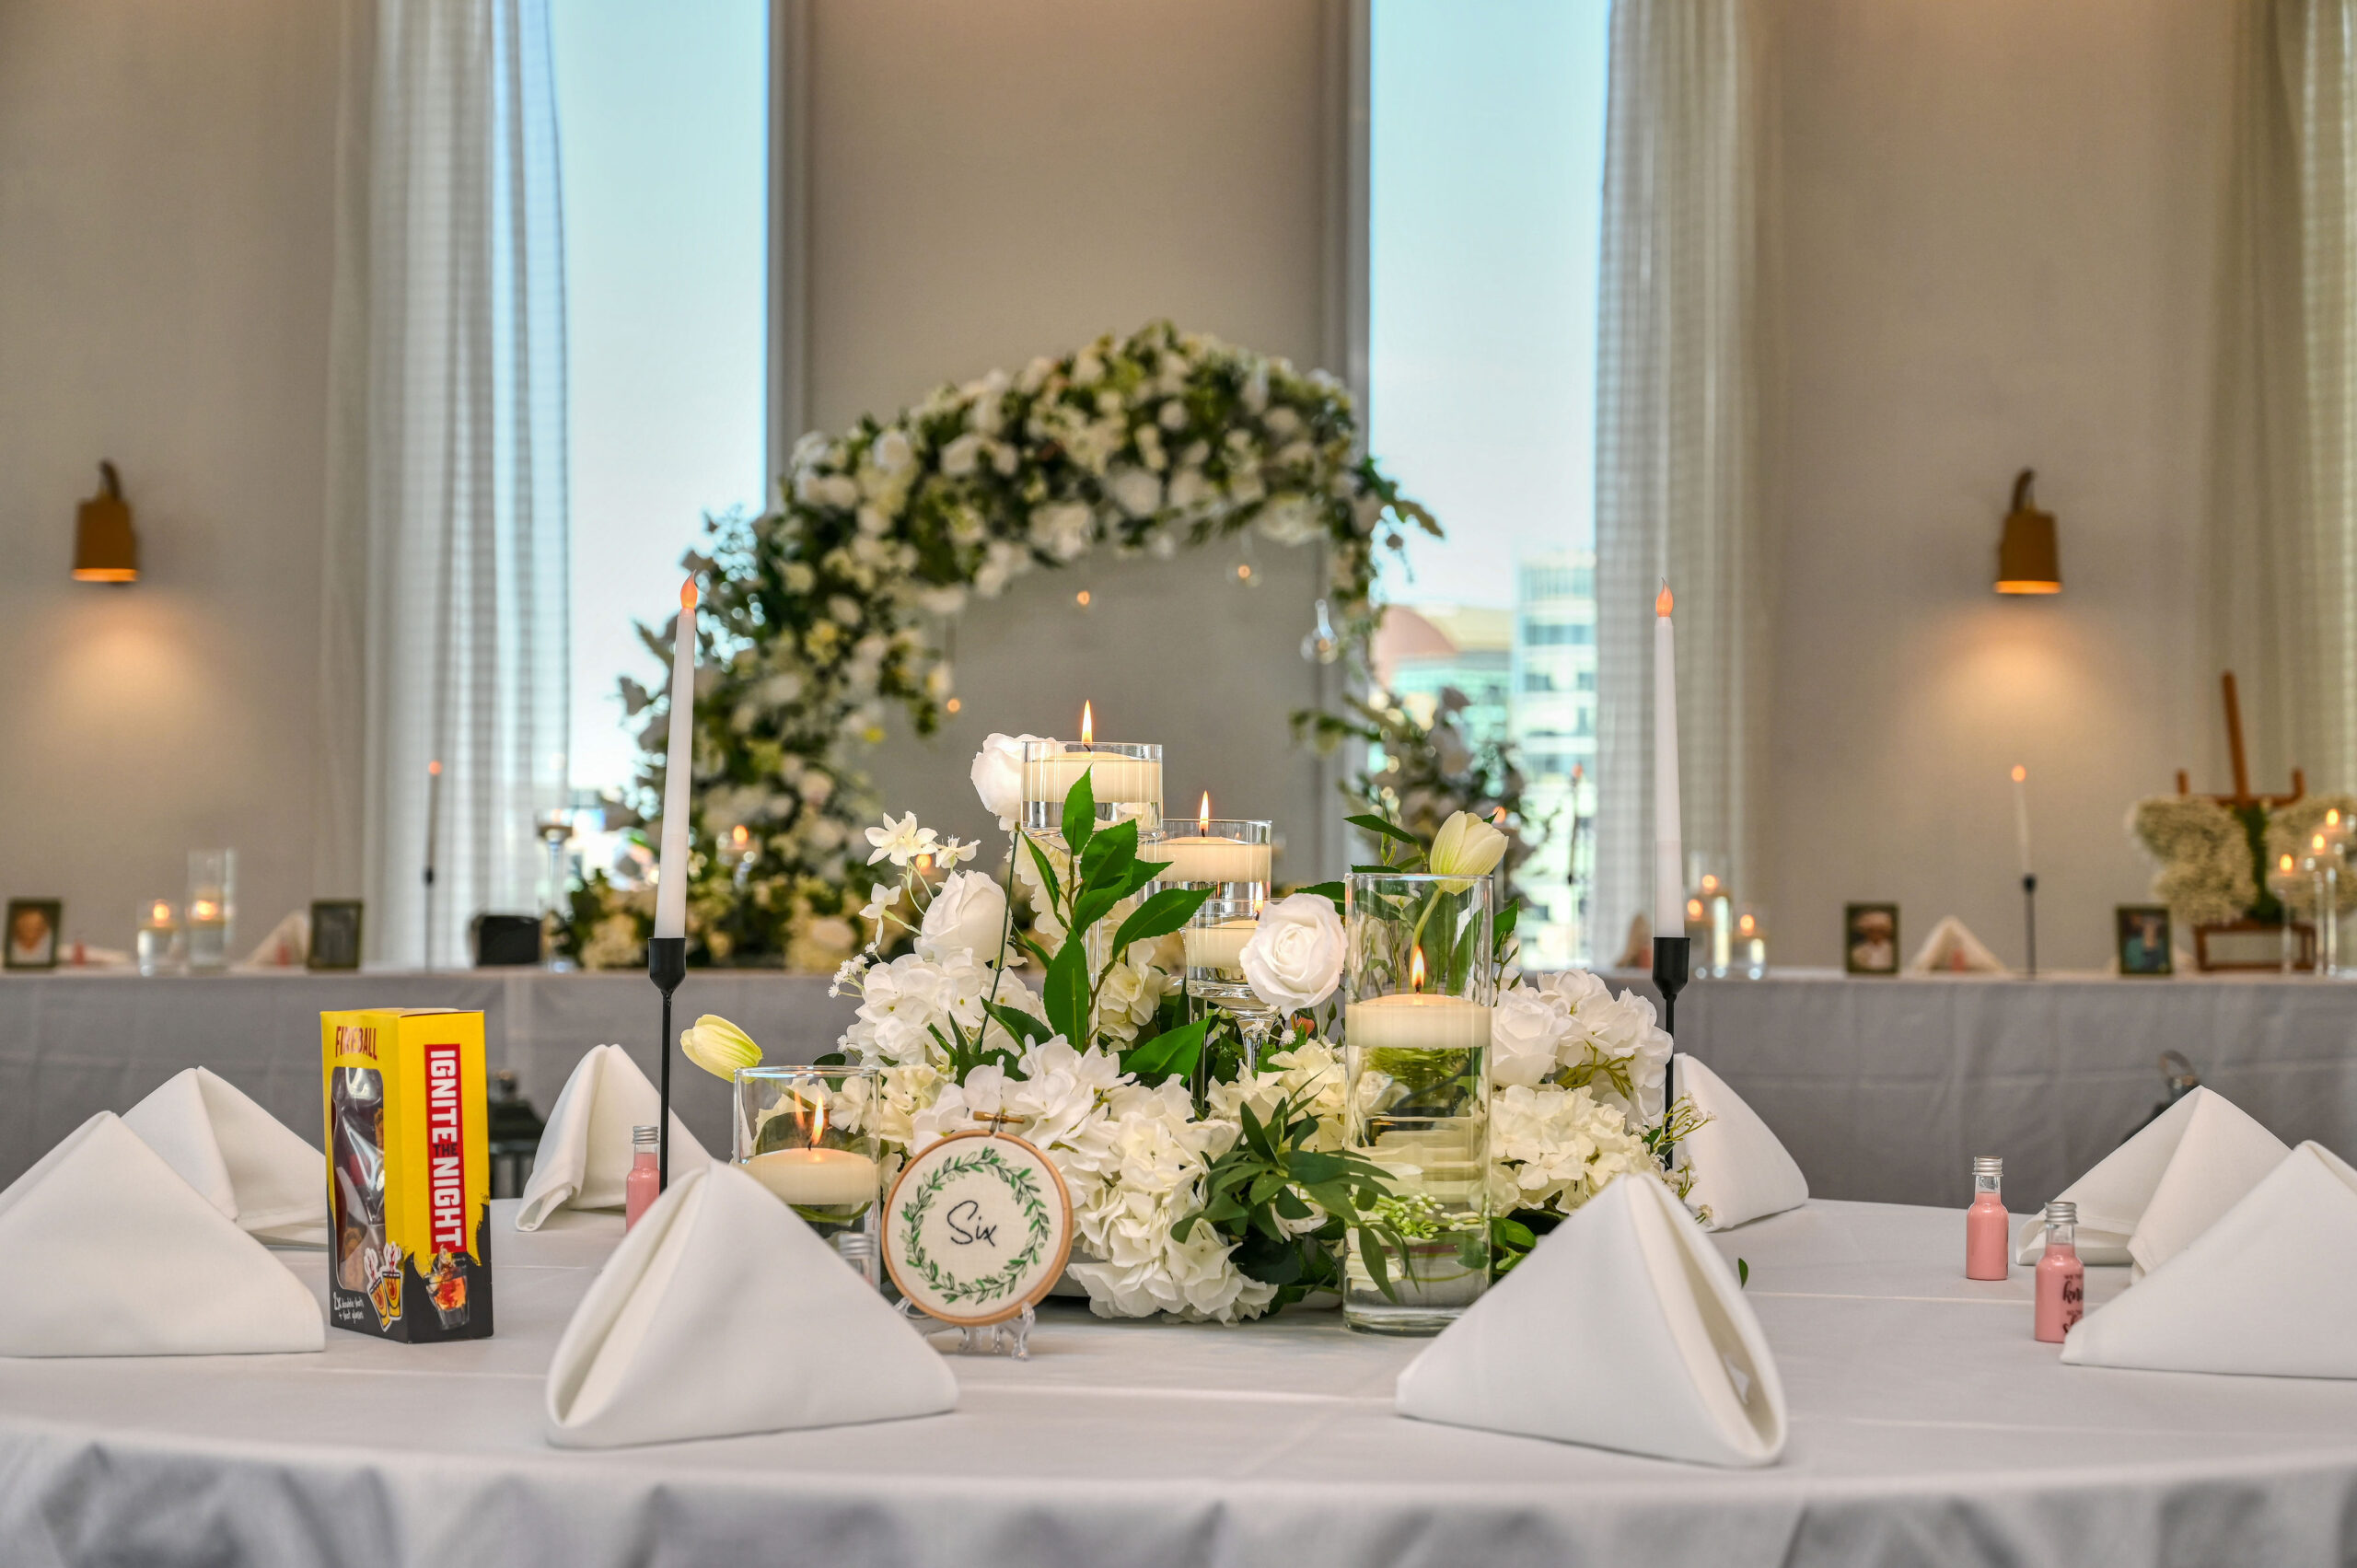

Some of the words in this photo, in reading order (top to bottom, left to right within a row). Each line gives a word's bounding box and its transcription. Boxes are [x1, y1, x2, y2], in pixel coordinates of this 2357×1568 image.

[335, 1026, 377, 1061] FIREBALL
[430, 1051, 458, 1144] IGNITE
[434, 1143, 459, 1157] THE
[433, 1156, 462, 1247] NIGHT
[946, 1200, 997, 1248] Six
